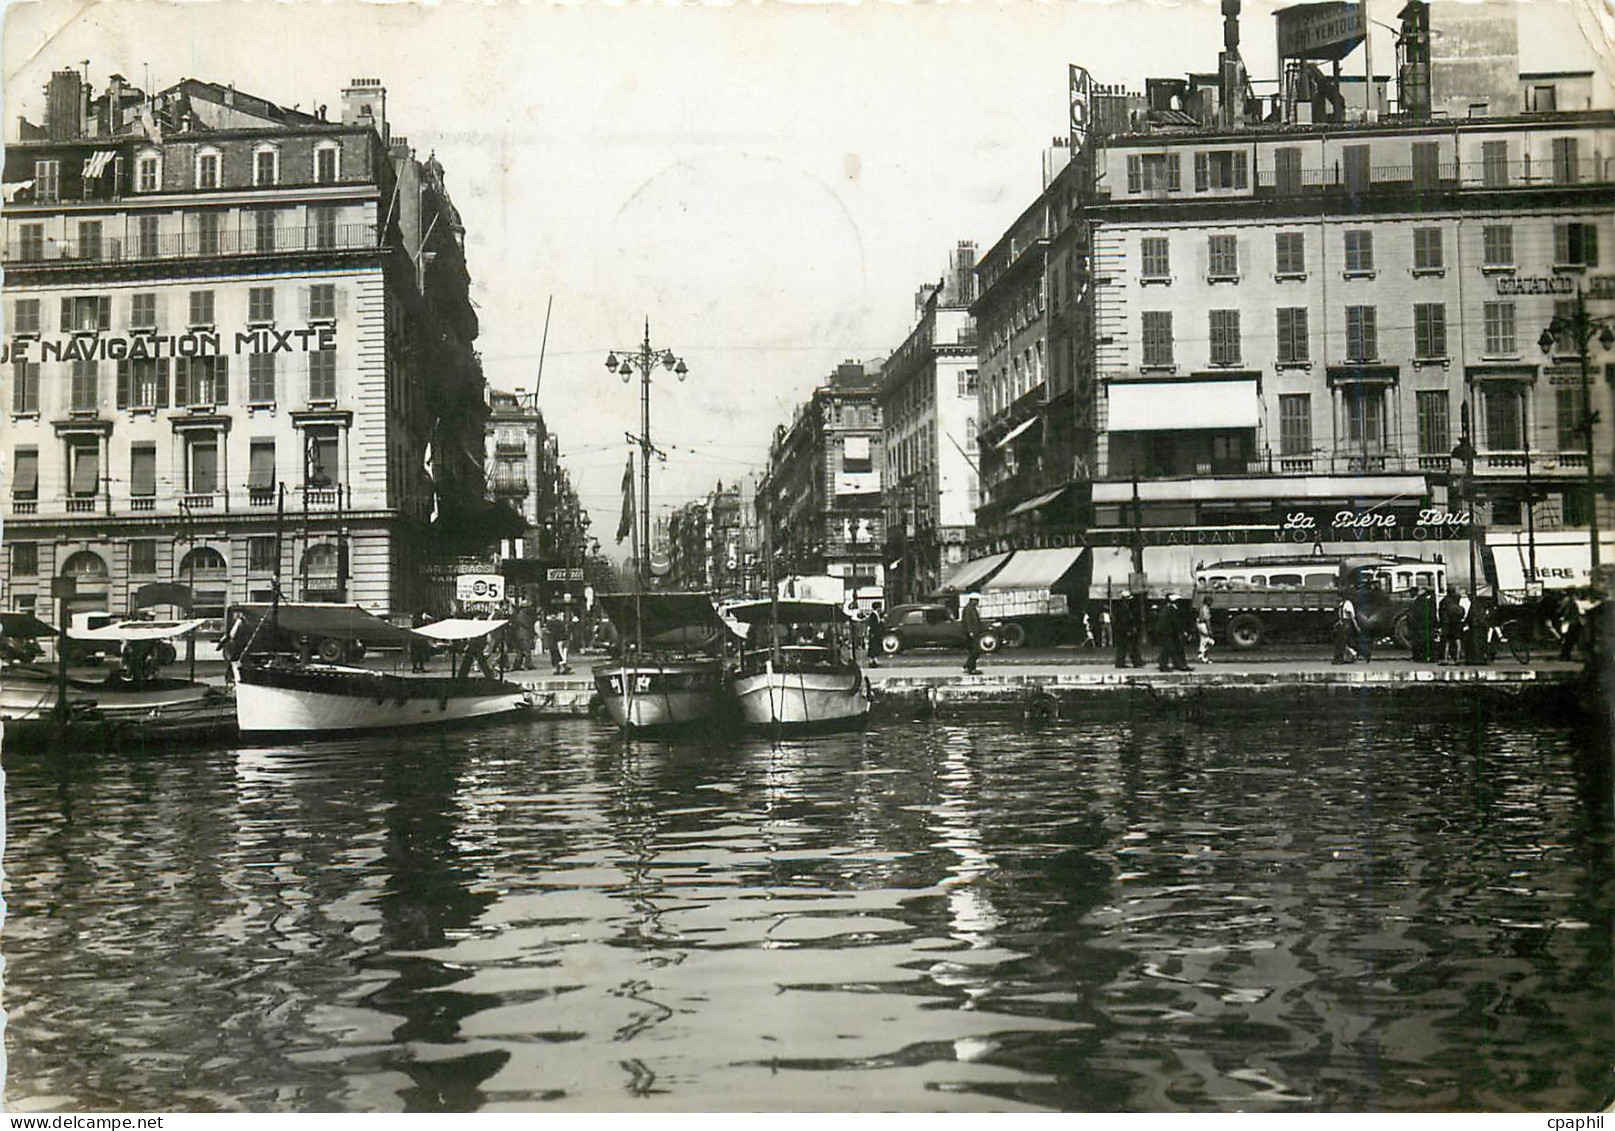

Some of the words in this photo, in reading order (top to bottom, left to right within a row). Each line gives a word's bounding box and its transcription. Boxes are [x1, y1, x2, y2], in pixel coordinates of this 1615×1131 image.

[41, 332, 220, 362] NAVIGATION
[235, 329, 337, 355] MIXTE
[1284, 512, 1316, 529] La
[1111, 530, 1253, 545] RESTAURANT
[488, 583, 498, 598] 5
